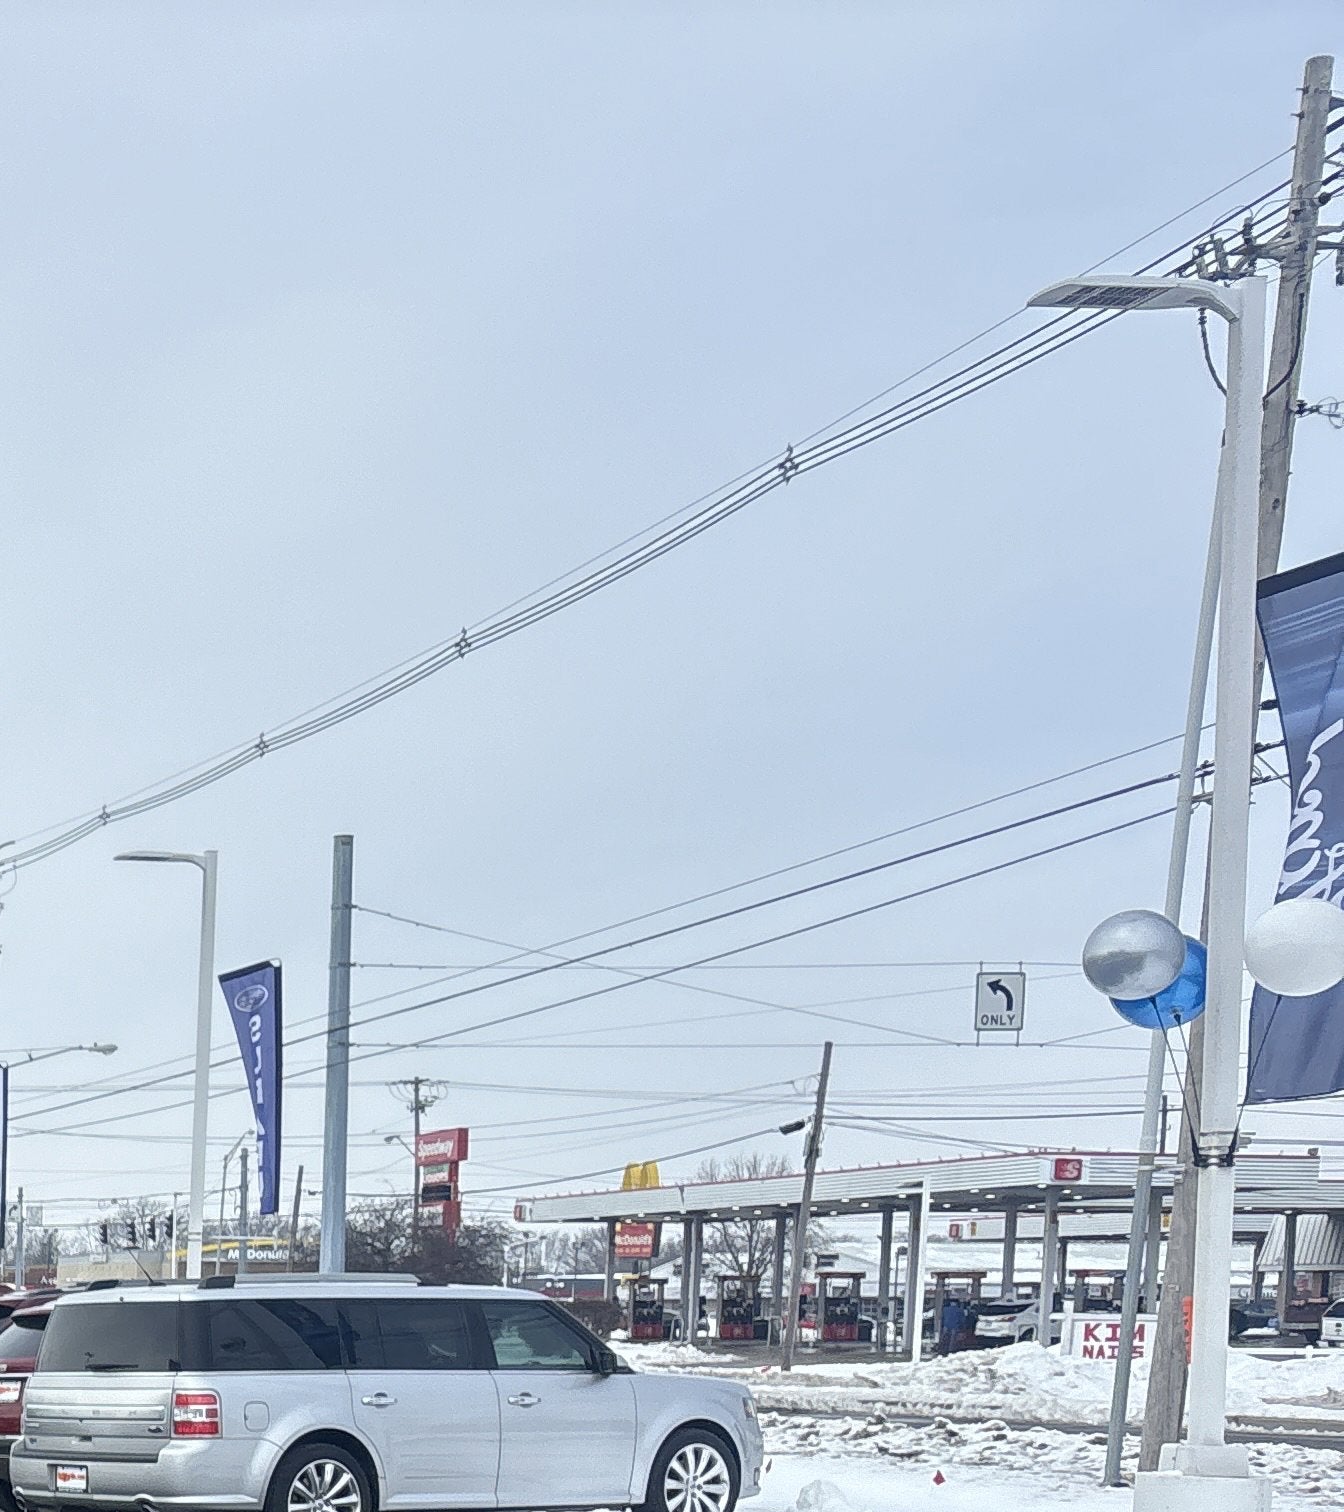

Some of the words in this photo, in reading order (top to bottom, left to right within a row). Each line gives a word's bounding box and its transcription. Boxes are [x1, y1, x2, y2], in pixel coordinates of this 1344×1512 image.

[980, 1013, 1016, 1026] ONLY
[1083, 1322, 1146, 1343] KIM
[1082, 1344, 1145, 1360] NAIS
